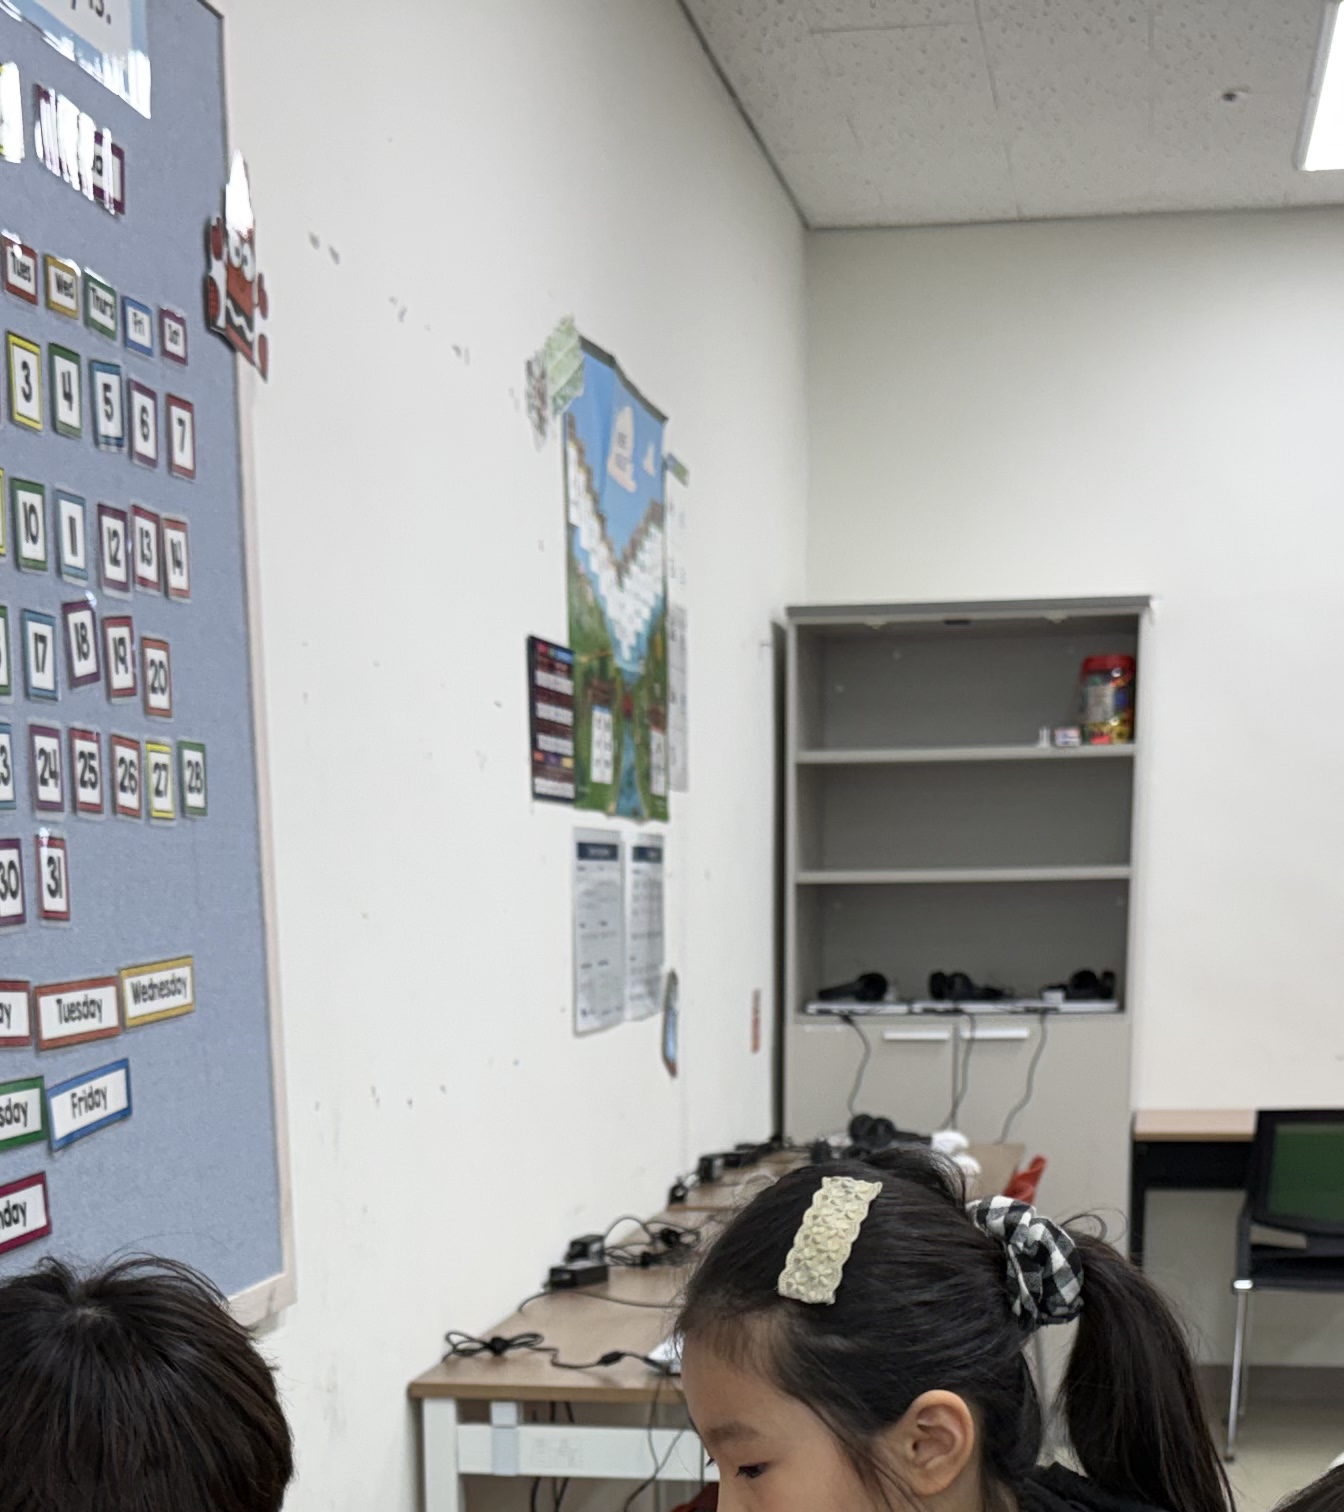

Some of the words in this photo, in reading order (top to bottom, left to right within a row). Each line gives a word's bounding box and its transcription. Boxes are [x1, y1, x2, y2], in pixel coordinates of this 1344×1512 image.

[11, 251, 32, 283] Tues
[21, 360, 33, 403] 3
[61, 370, 74, 412] 4
[102, 382, 114, 421] 5
[140, 405, 150, 443] 6
[177, 418, 187, 452] 7
[22, 501, 39, 545] 10
[68, 515, 79, 556] 11
[107, 525, 122, 568] 12
[138, 523, 153, 567] 13
[32, 632, 48, 674] 17
[74, 622, 90, 663] 18
[113, 636, 128, 676] 19
[149, 658, 169, 695] 20
[37, 747, 59, 789] 24
[78, 750, 99, 790] 25
[117, 755, 139, 795] 26
[153, 761, 169, 798] 27
[46, 855, 64, 899] 31
[56, 994, 103, 1025] Tuesday
[131, 973, 187, 1006] Wednesday
[71, 1084, 107, 1120] Friday
